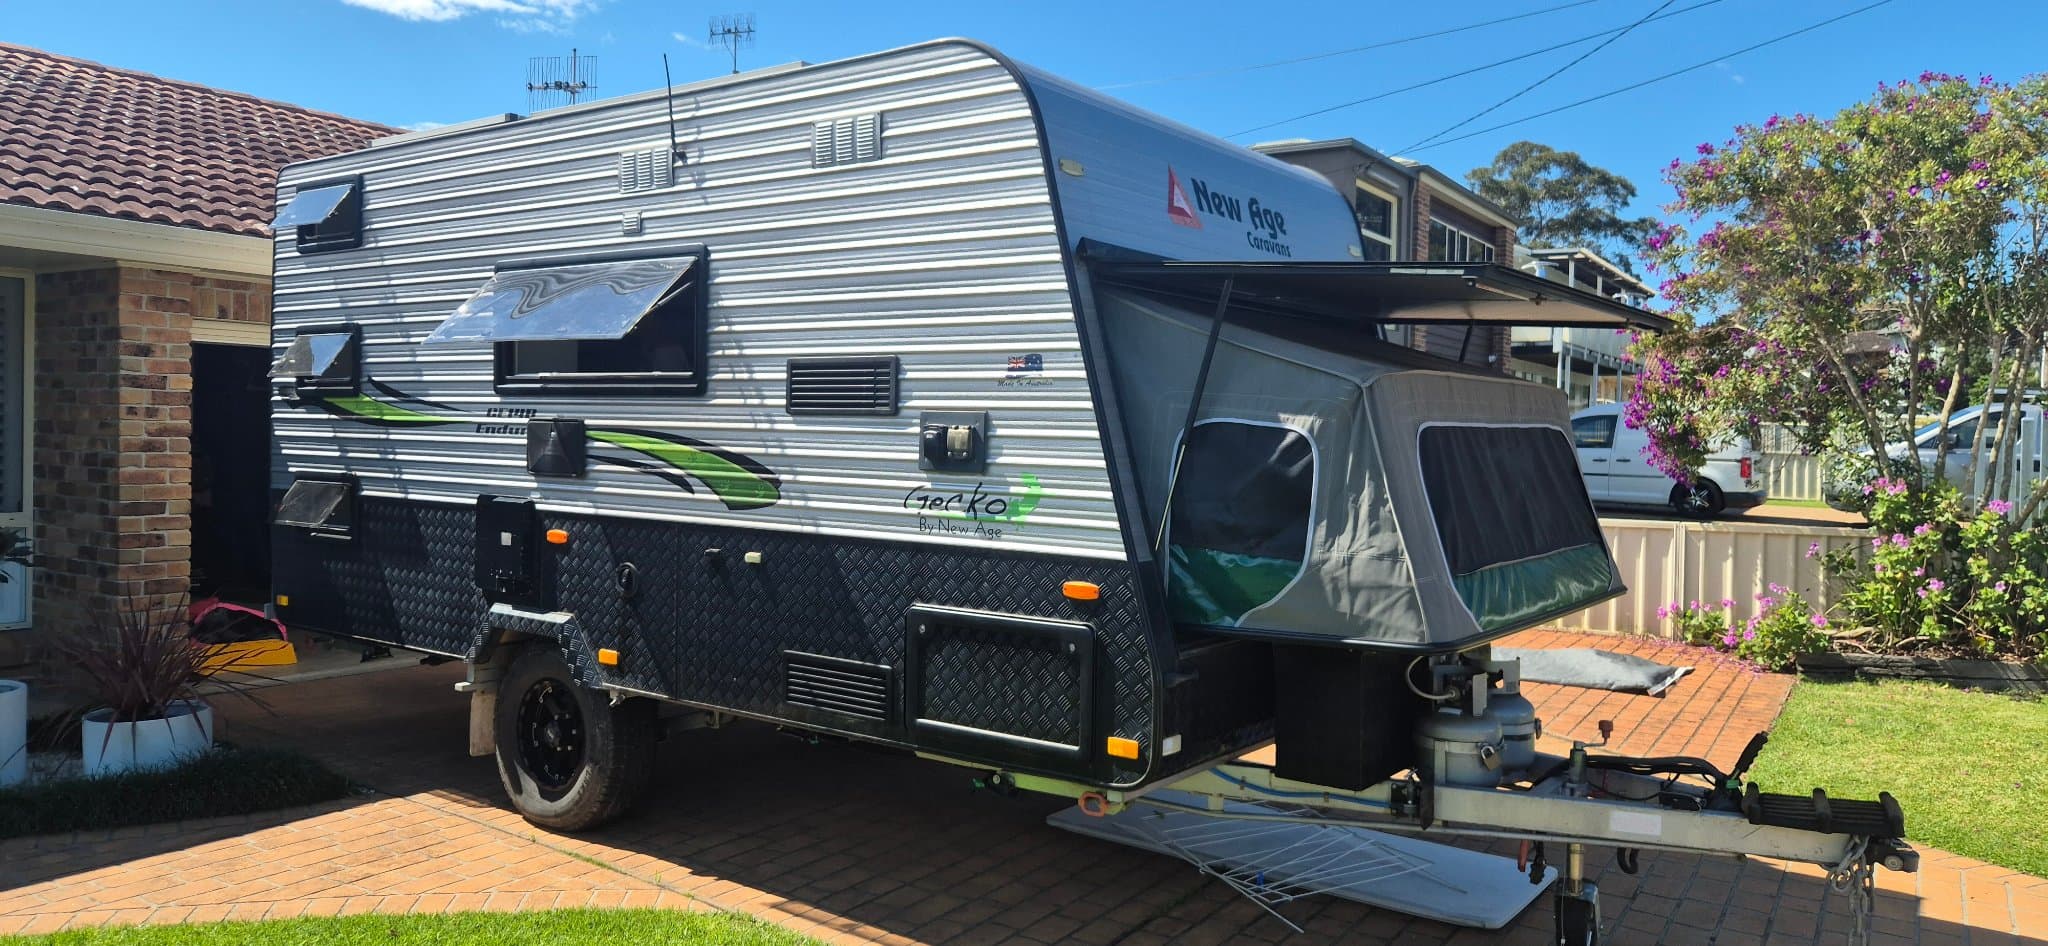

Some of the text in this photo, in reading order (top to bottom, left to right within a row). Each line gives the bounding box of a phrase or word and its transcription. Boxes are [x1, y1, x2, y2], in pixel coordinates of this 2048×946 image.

[1190, 177, 1287, 240] New Age
[1247, 231, 1292, 257] Caravans
[903, 481, 1008, 520] Gecko
[919, 517, 1002, 540] By New Age
